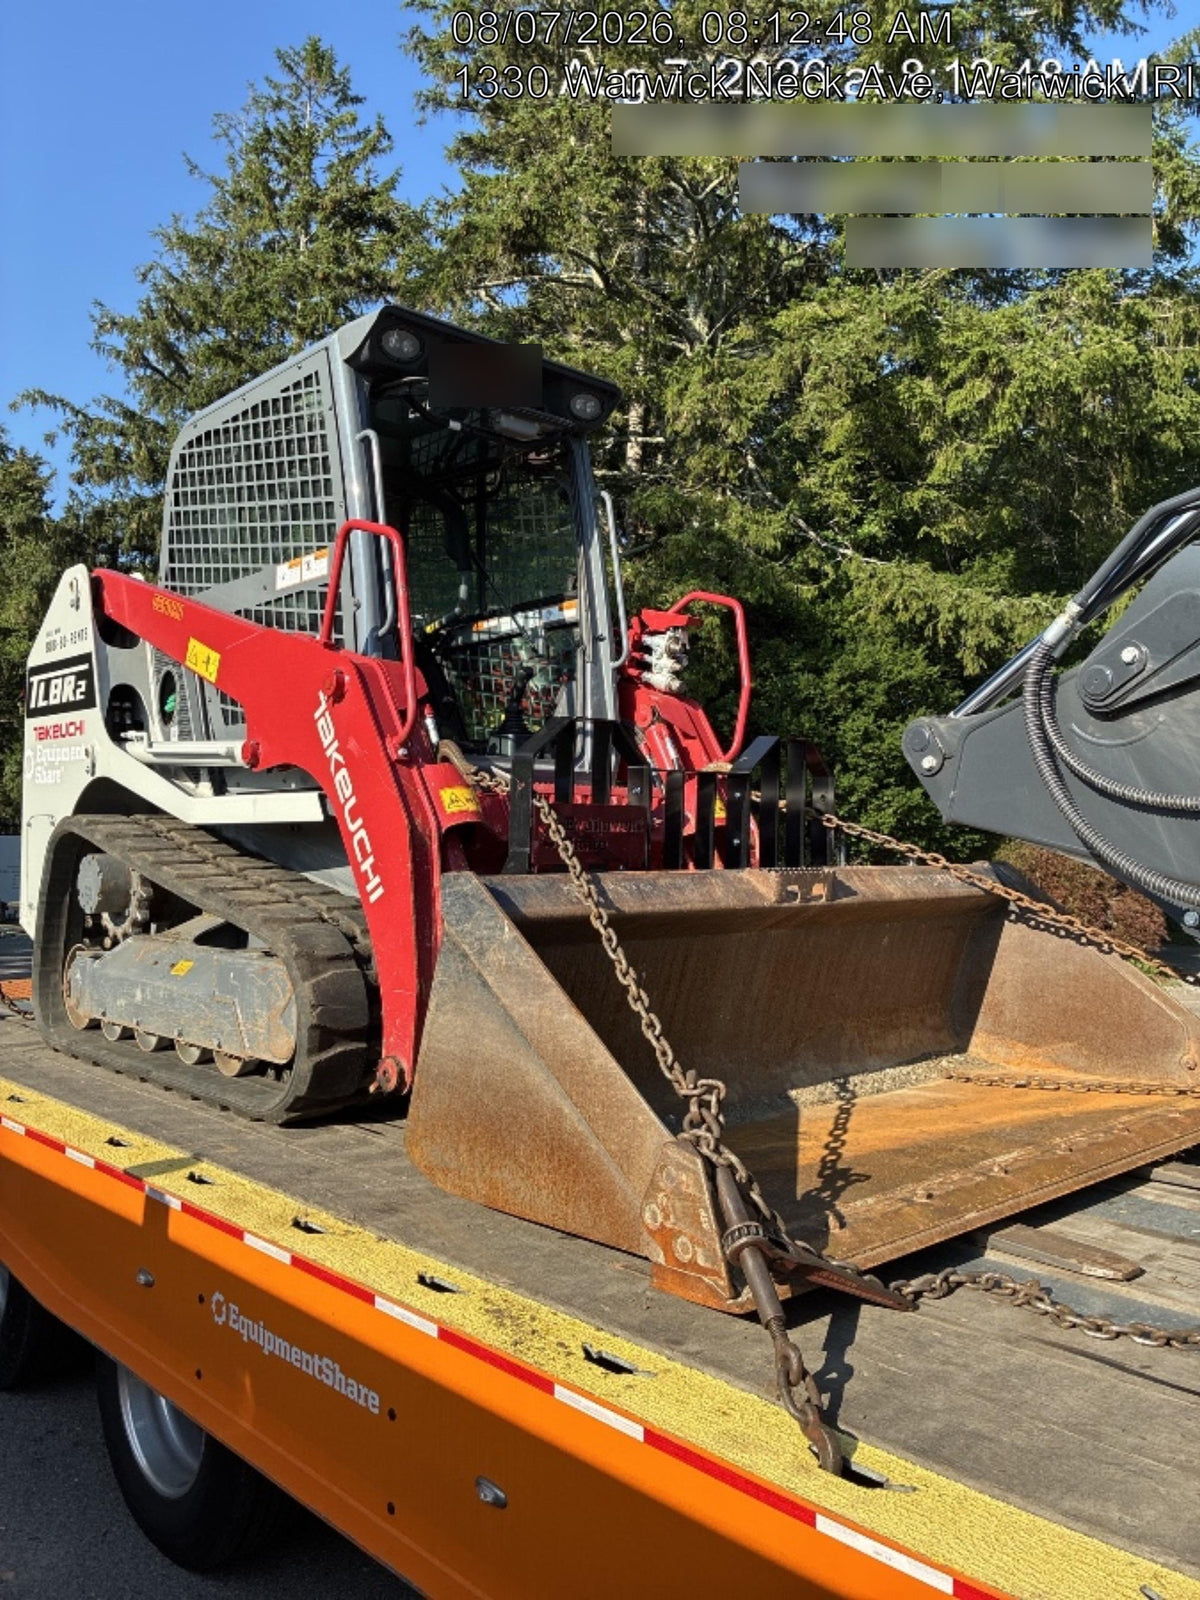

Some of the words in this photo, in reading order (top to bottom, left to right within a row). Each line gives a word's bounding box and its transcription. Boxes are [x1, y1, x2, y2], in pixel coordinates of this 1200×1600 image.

[33, 719, 86, 742] TAKEUCHI
[313, 689, 385, 904] TAKEUCHI
[228, 1302, 381, 1415] EquipmentShare
